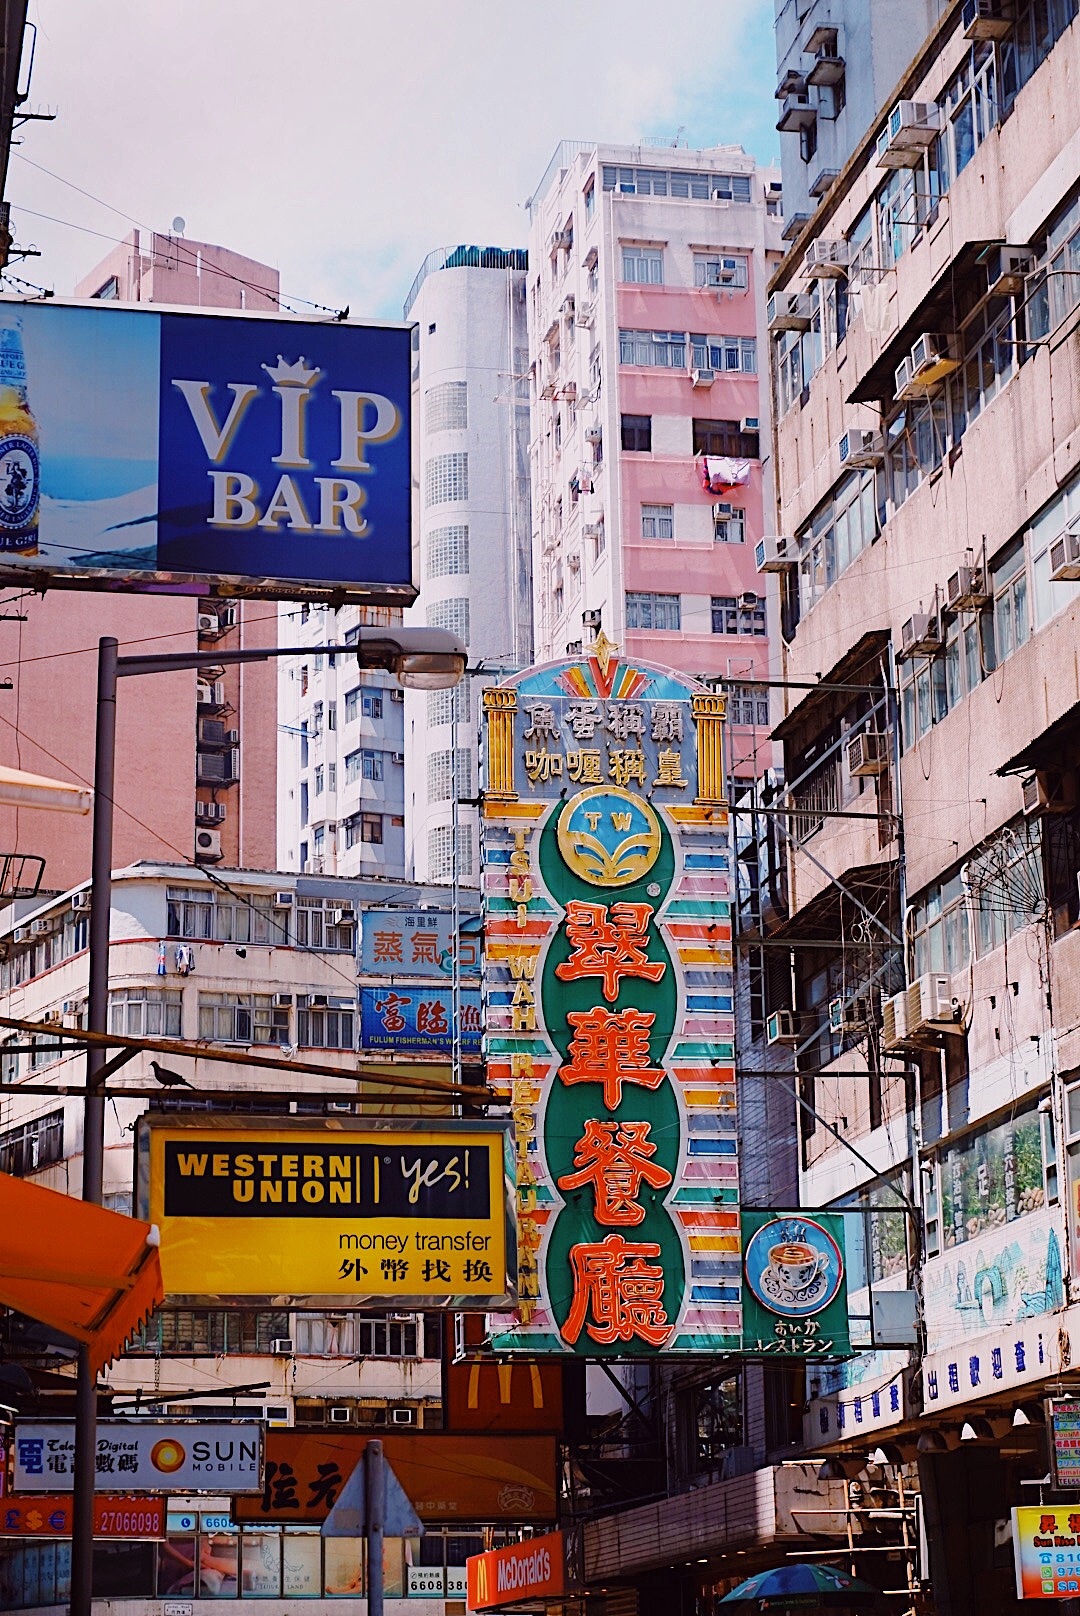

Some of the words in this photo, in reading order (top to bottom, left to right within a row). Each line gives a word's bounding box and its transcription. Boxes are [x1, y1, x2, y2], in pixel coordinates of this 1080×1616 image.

[171, 378, 400, 471] VIP
[206, 470, 370, 536] BAR
[523, 700, 684, 743] 魚蛋稱霸
[524, 746, 690, 788] 咖喱稱皇
[509, 827, 533, 928] TSUI
[508, 955, 537, 1031] WAH
[369, 1035, 394, 1044] FULUM
[445, 1037, 471, 1046] WRF
[554, 899, 676, 1346] 翠華餐廳
[177, 1153, 351, 1178] WESTERN
[400, 1149, 470, 1204] yes!
[233, 1179, 351, 1203] UNION
[339, 1233, 408, 1253] money
[415, 1231, 492, 1251] transfer
[757, 1338, 833, 1353] レストラン
[47, 1439, 76, 1452] Tele
[97, 1439, 139, 1453] Digital
[192, 1441, 257, 1462] SUN
[192, 1463, 256, 1472] MOBILE
[101, 1511, 159, 1533] 27066098
[410, 1581, 443, 1591] 6608
[497, 1547, 551, 1592] McDonald's
